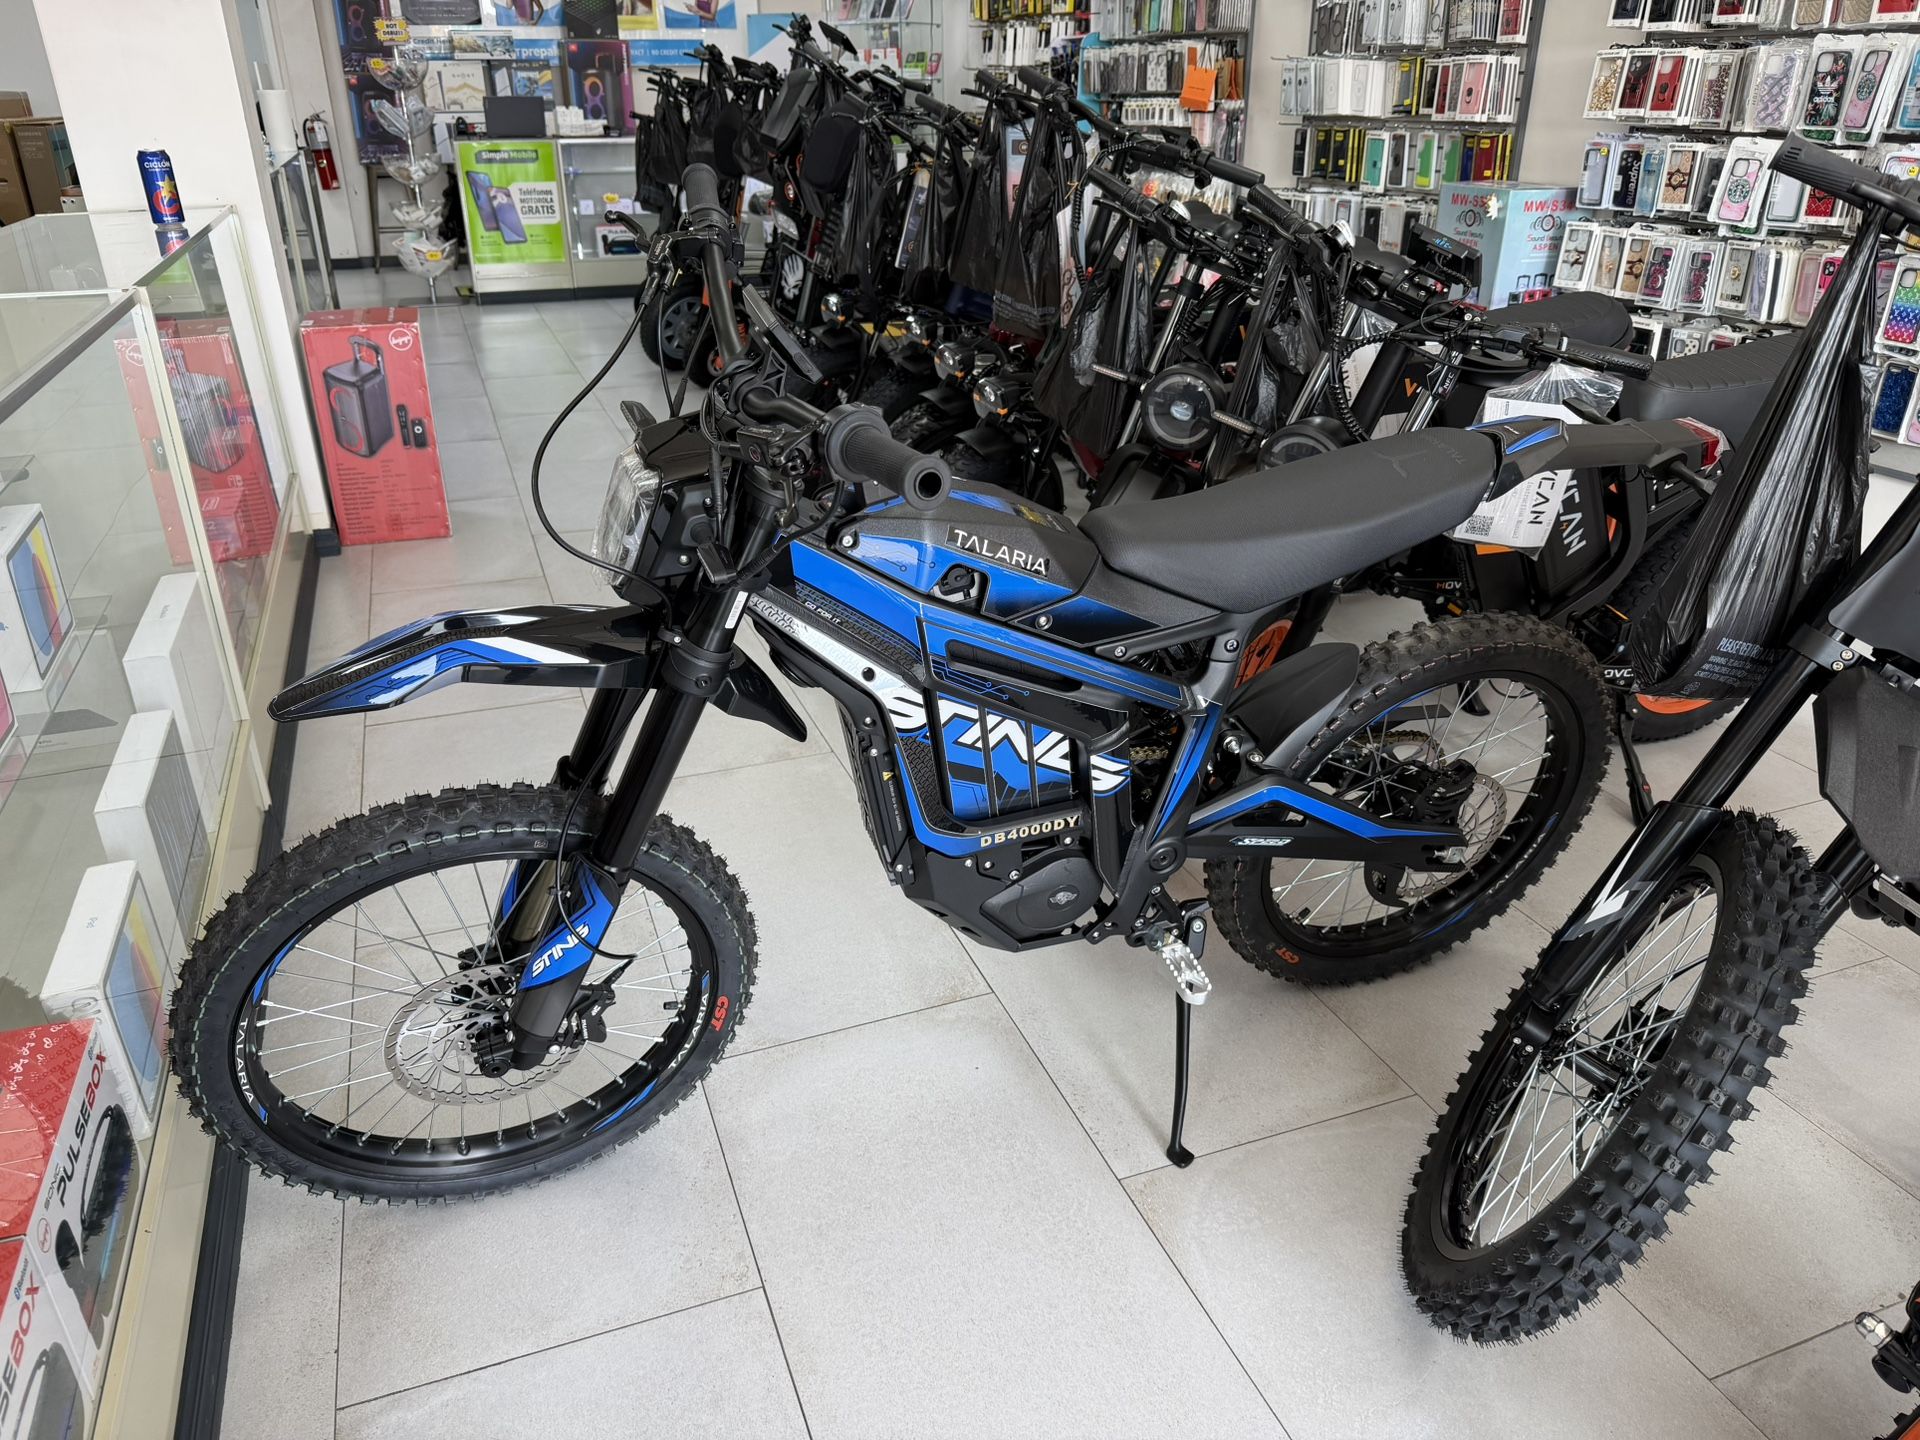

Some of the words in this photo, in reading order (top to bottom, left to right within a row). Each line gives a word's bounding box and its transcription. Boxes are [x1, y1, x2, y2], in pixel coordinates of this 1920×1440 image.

[481, 151, 508, 160] Simple
[509, 151, 537, 159] Mobile
[518, 188, 553, 196] Teléfonos
[1625, 160, 1641, 205] Supreme
[521, 205, 556, 216] GRATIS
[1443, 372, 1455, 389] NFC
[953, 529, 1047, 575] TALARIA
[805, 601, 817, 609] GO
[817, 608, 833, 620] FOR
[832, 616, 841, 624] IT
[980, 814, 1079, 848] DB4000DY
[531, 922, 592, 978] STING
[1275, 947, 1301, 964] CST
[667, 992, 710, 1070] TALARIA
[711, 995, 730, 1032] CST
[235, 1017, 255, 1103] TALARIA
[55, 1052, 107, 1208] PULSEBOX
